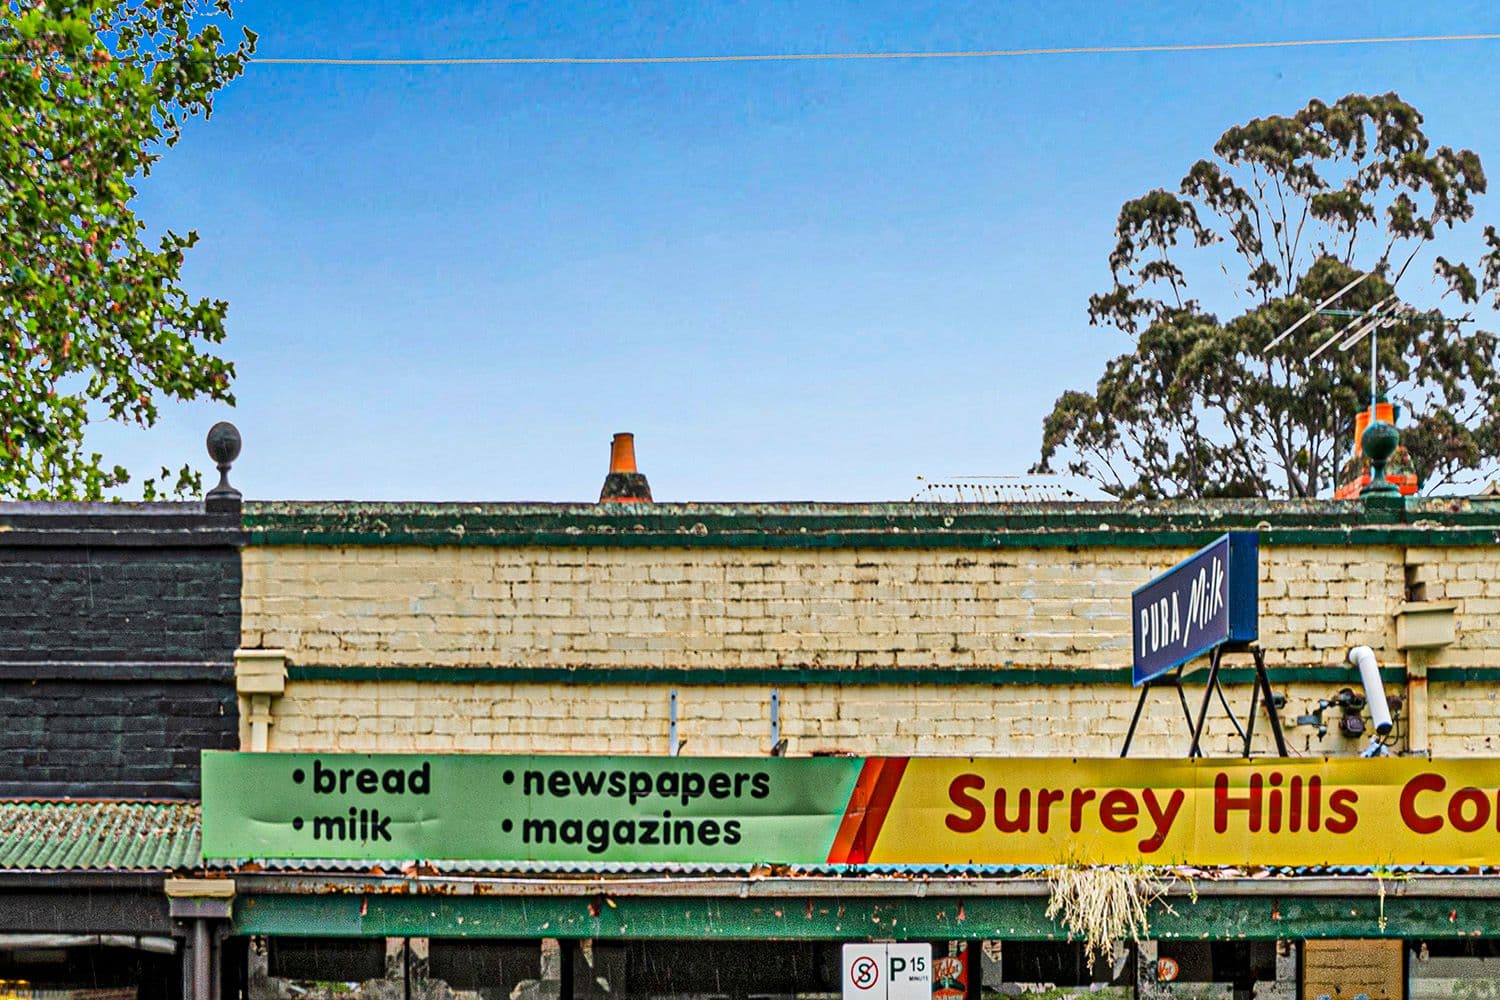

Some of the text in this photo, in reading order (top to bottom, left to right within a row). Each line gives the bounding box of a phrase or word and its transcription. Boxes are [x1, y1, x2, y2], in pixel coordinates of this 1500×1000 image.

[1140, 556, 1225, 658] PURA Milk
[313, 759, 431, 795] bread
[523, 768, 770, 805] newspapers
[313, 806, 392, 842] milk
[522, 809, 742, 854] magazines
[945, 773, 1185, 854] Surrey
[1214, 772, 1359, 834] Hills
[890, 957, 925, 981] P 15
